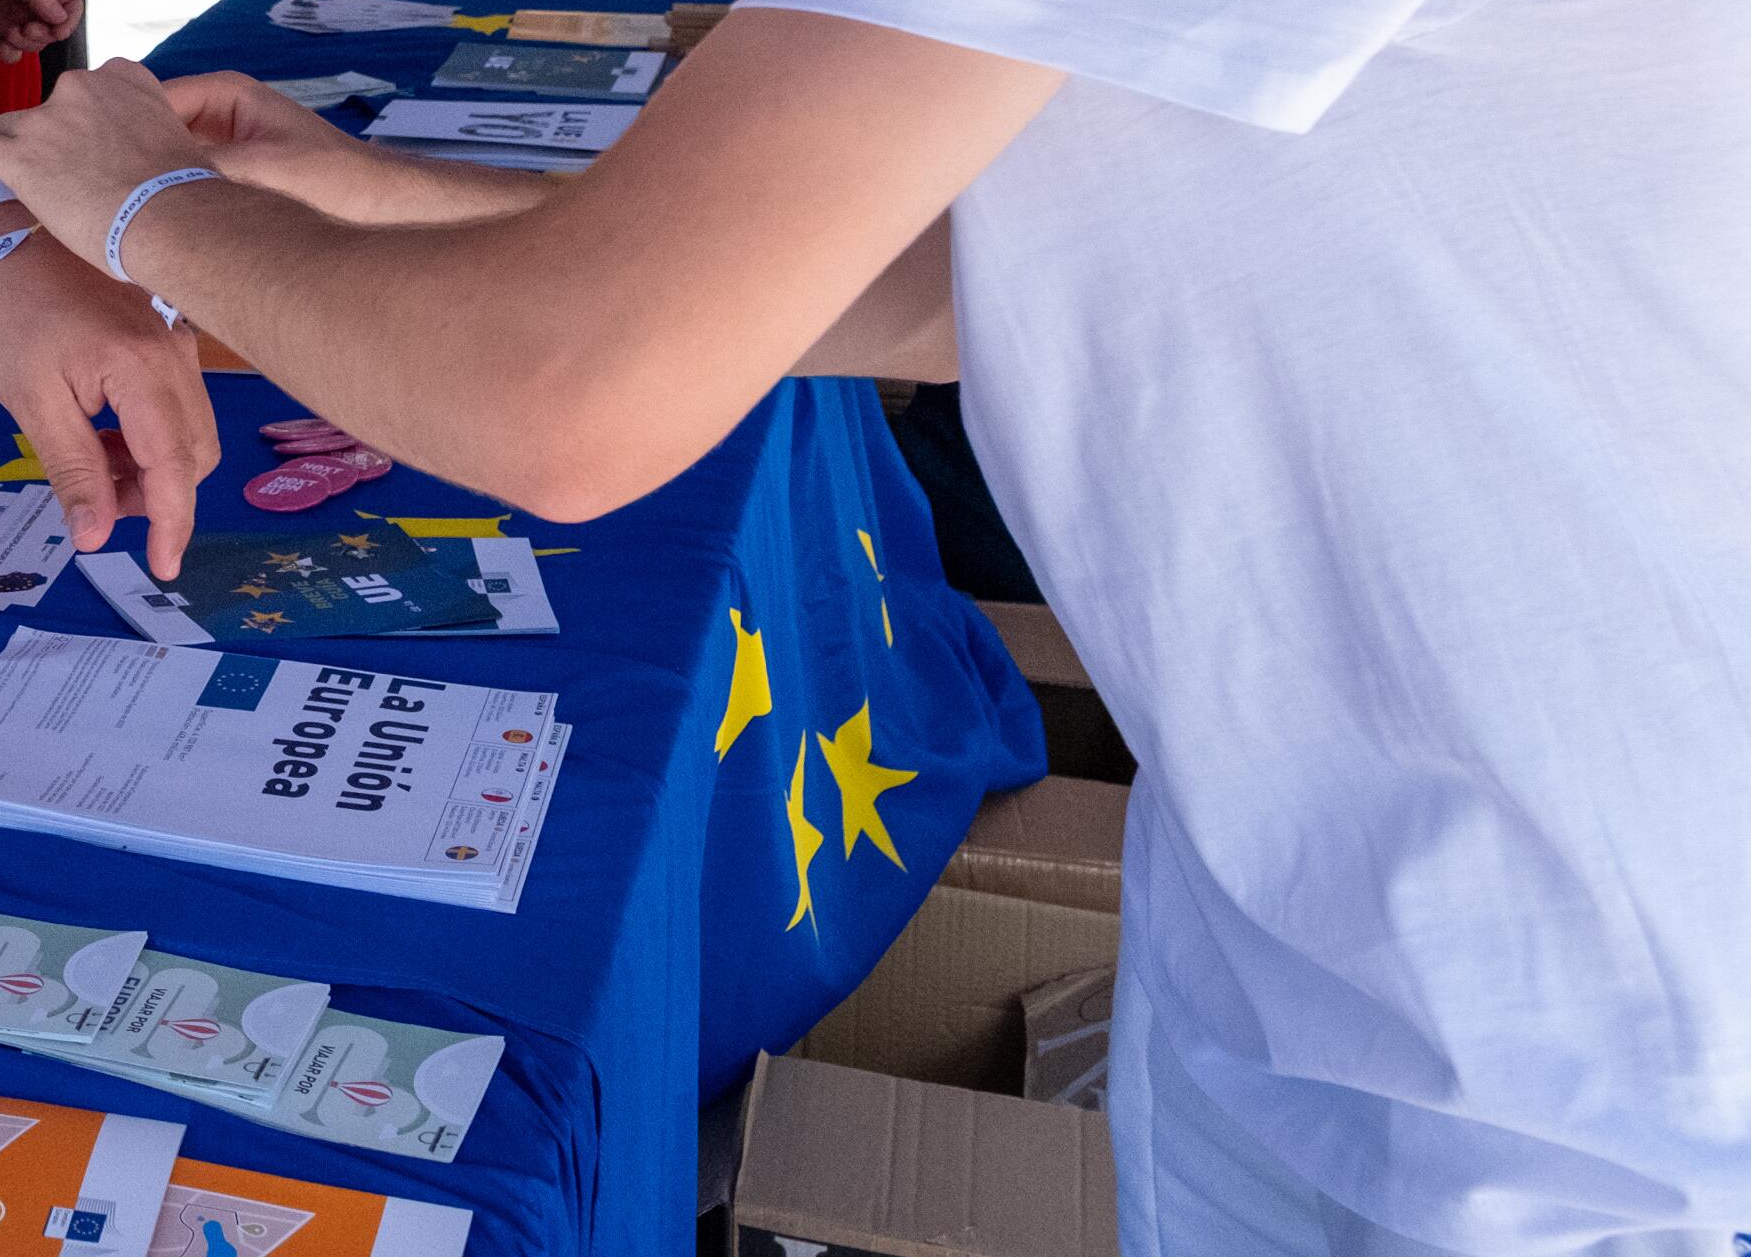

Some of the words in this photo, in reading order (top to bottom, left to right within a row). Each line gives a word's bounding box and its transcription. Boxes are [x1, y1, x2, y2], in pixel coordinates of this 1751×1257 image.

[458, 111, 555, 139] YO
[110, 224, 122, 244] de
[120, 188, 149, 223] Mayo
[341, 573, 403, 604] UE
[379, 676, 447, 714] La
[261, 665, 374, 798] Europea
[335, 720, 430, 812] Unión
[138, 987, 168, 1015] VIAJAR
[126, 1015, 149, 1033] POR
[308, 1044, 336, 1075] VIAJAR
[293, 1073, 317, 1095] POR
